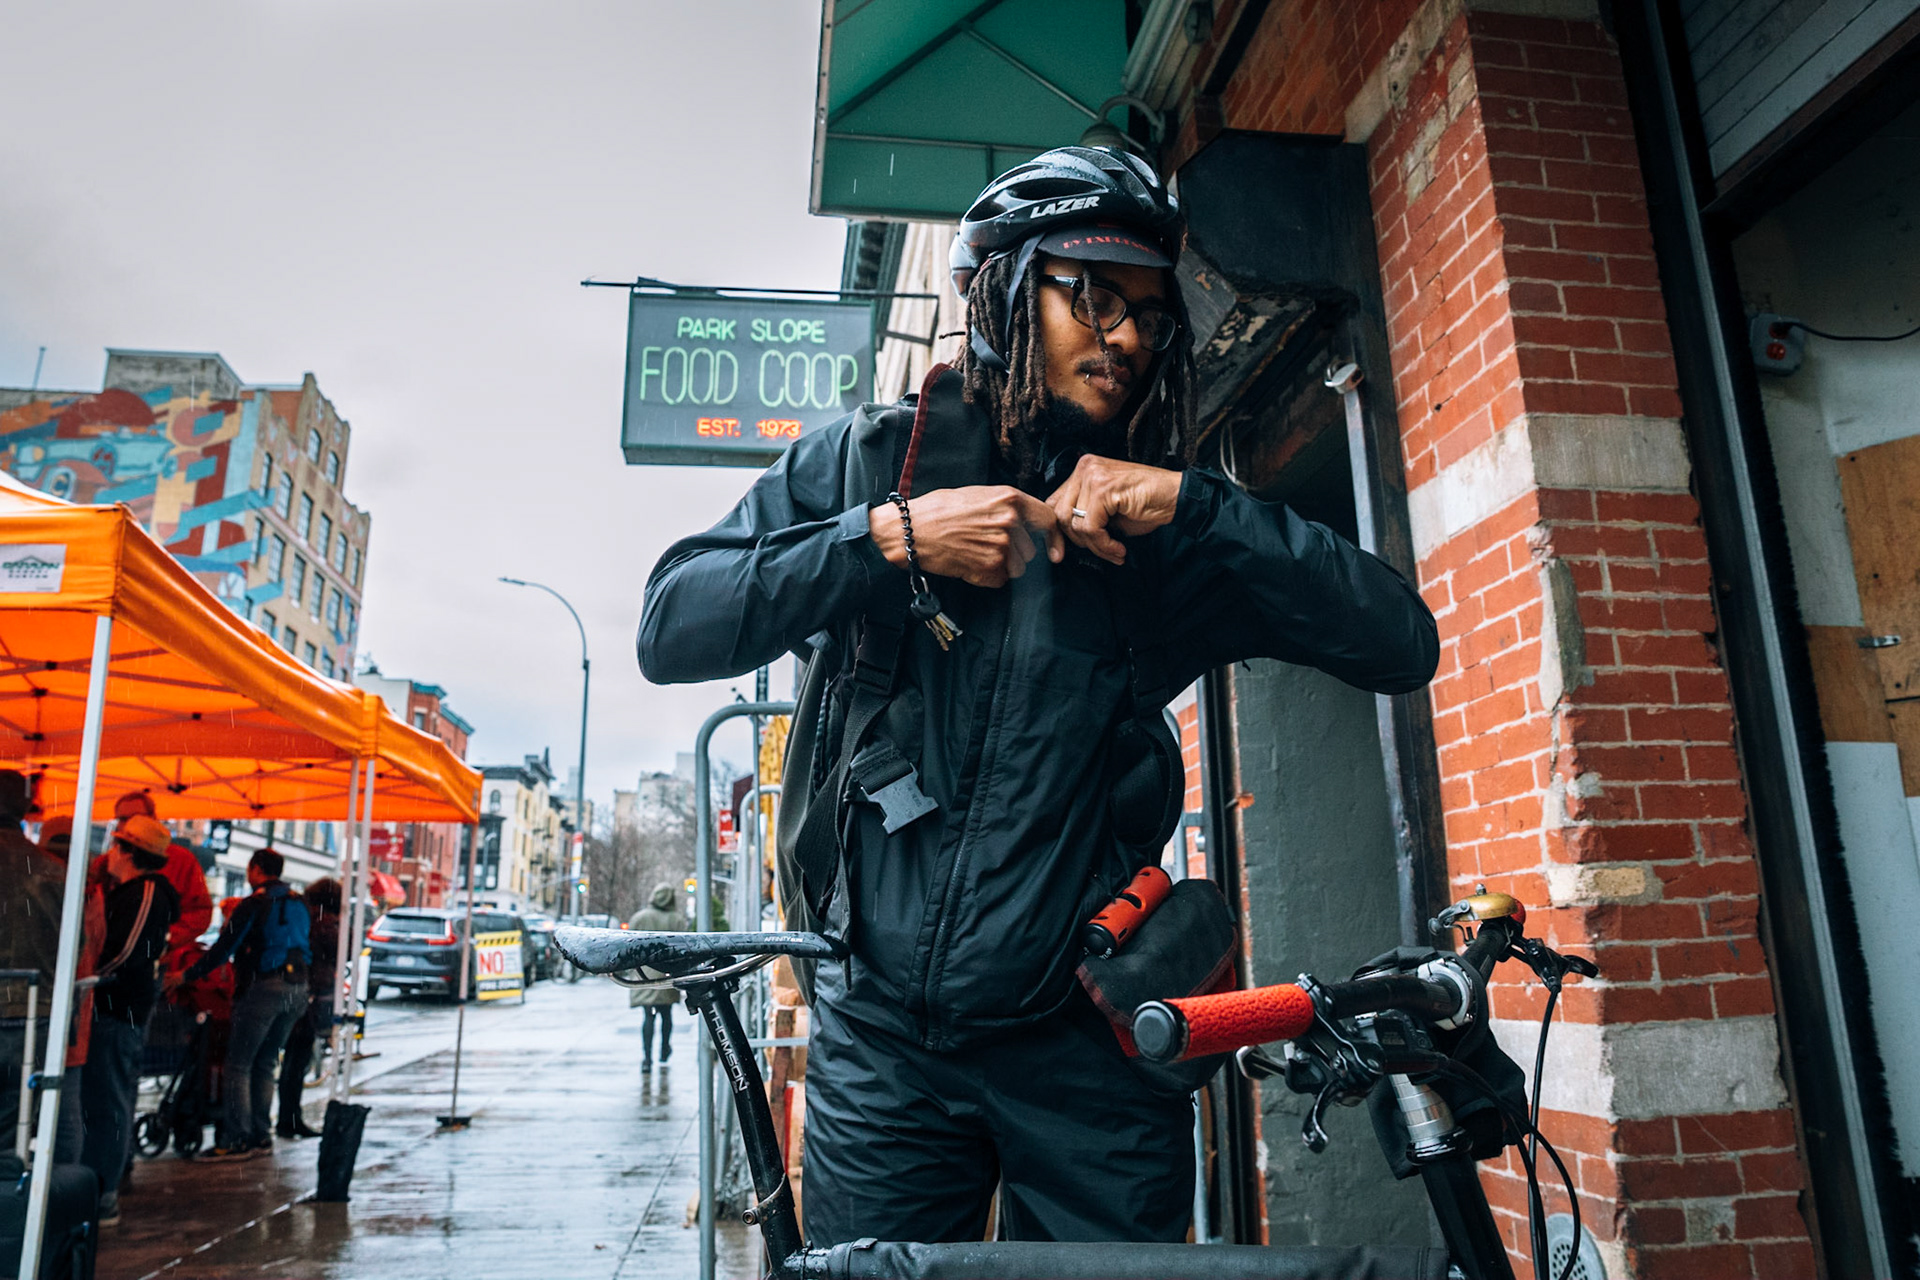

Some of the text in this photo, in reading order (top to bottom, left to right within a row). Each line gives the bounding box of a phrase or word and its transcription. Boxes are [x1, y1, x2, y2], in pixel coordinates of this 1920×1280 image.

[1030, 196, 1100, 219] LAZER
[677, 316, 826, 343] PARK SLOPE
[640, 346, 858, 409] FOOD COOP
[697, 418, 802, 438] EST. 1973
[480, 950, 504, 975] NO
[709, 1001, 748, 1092] THOMSON
